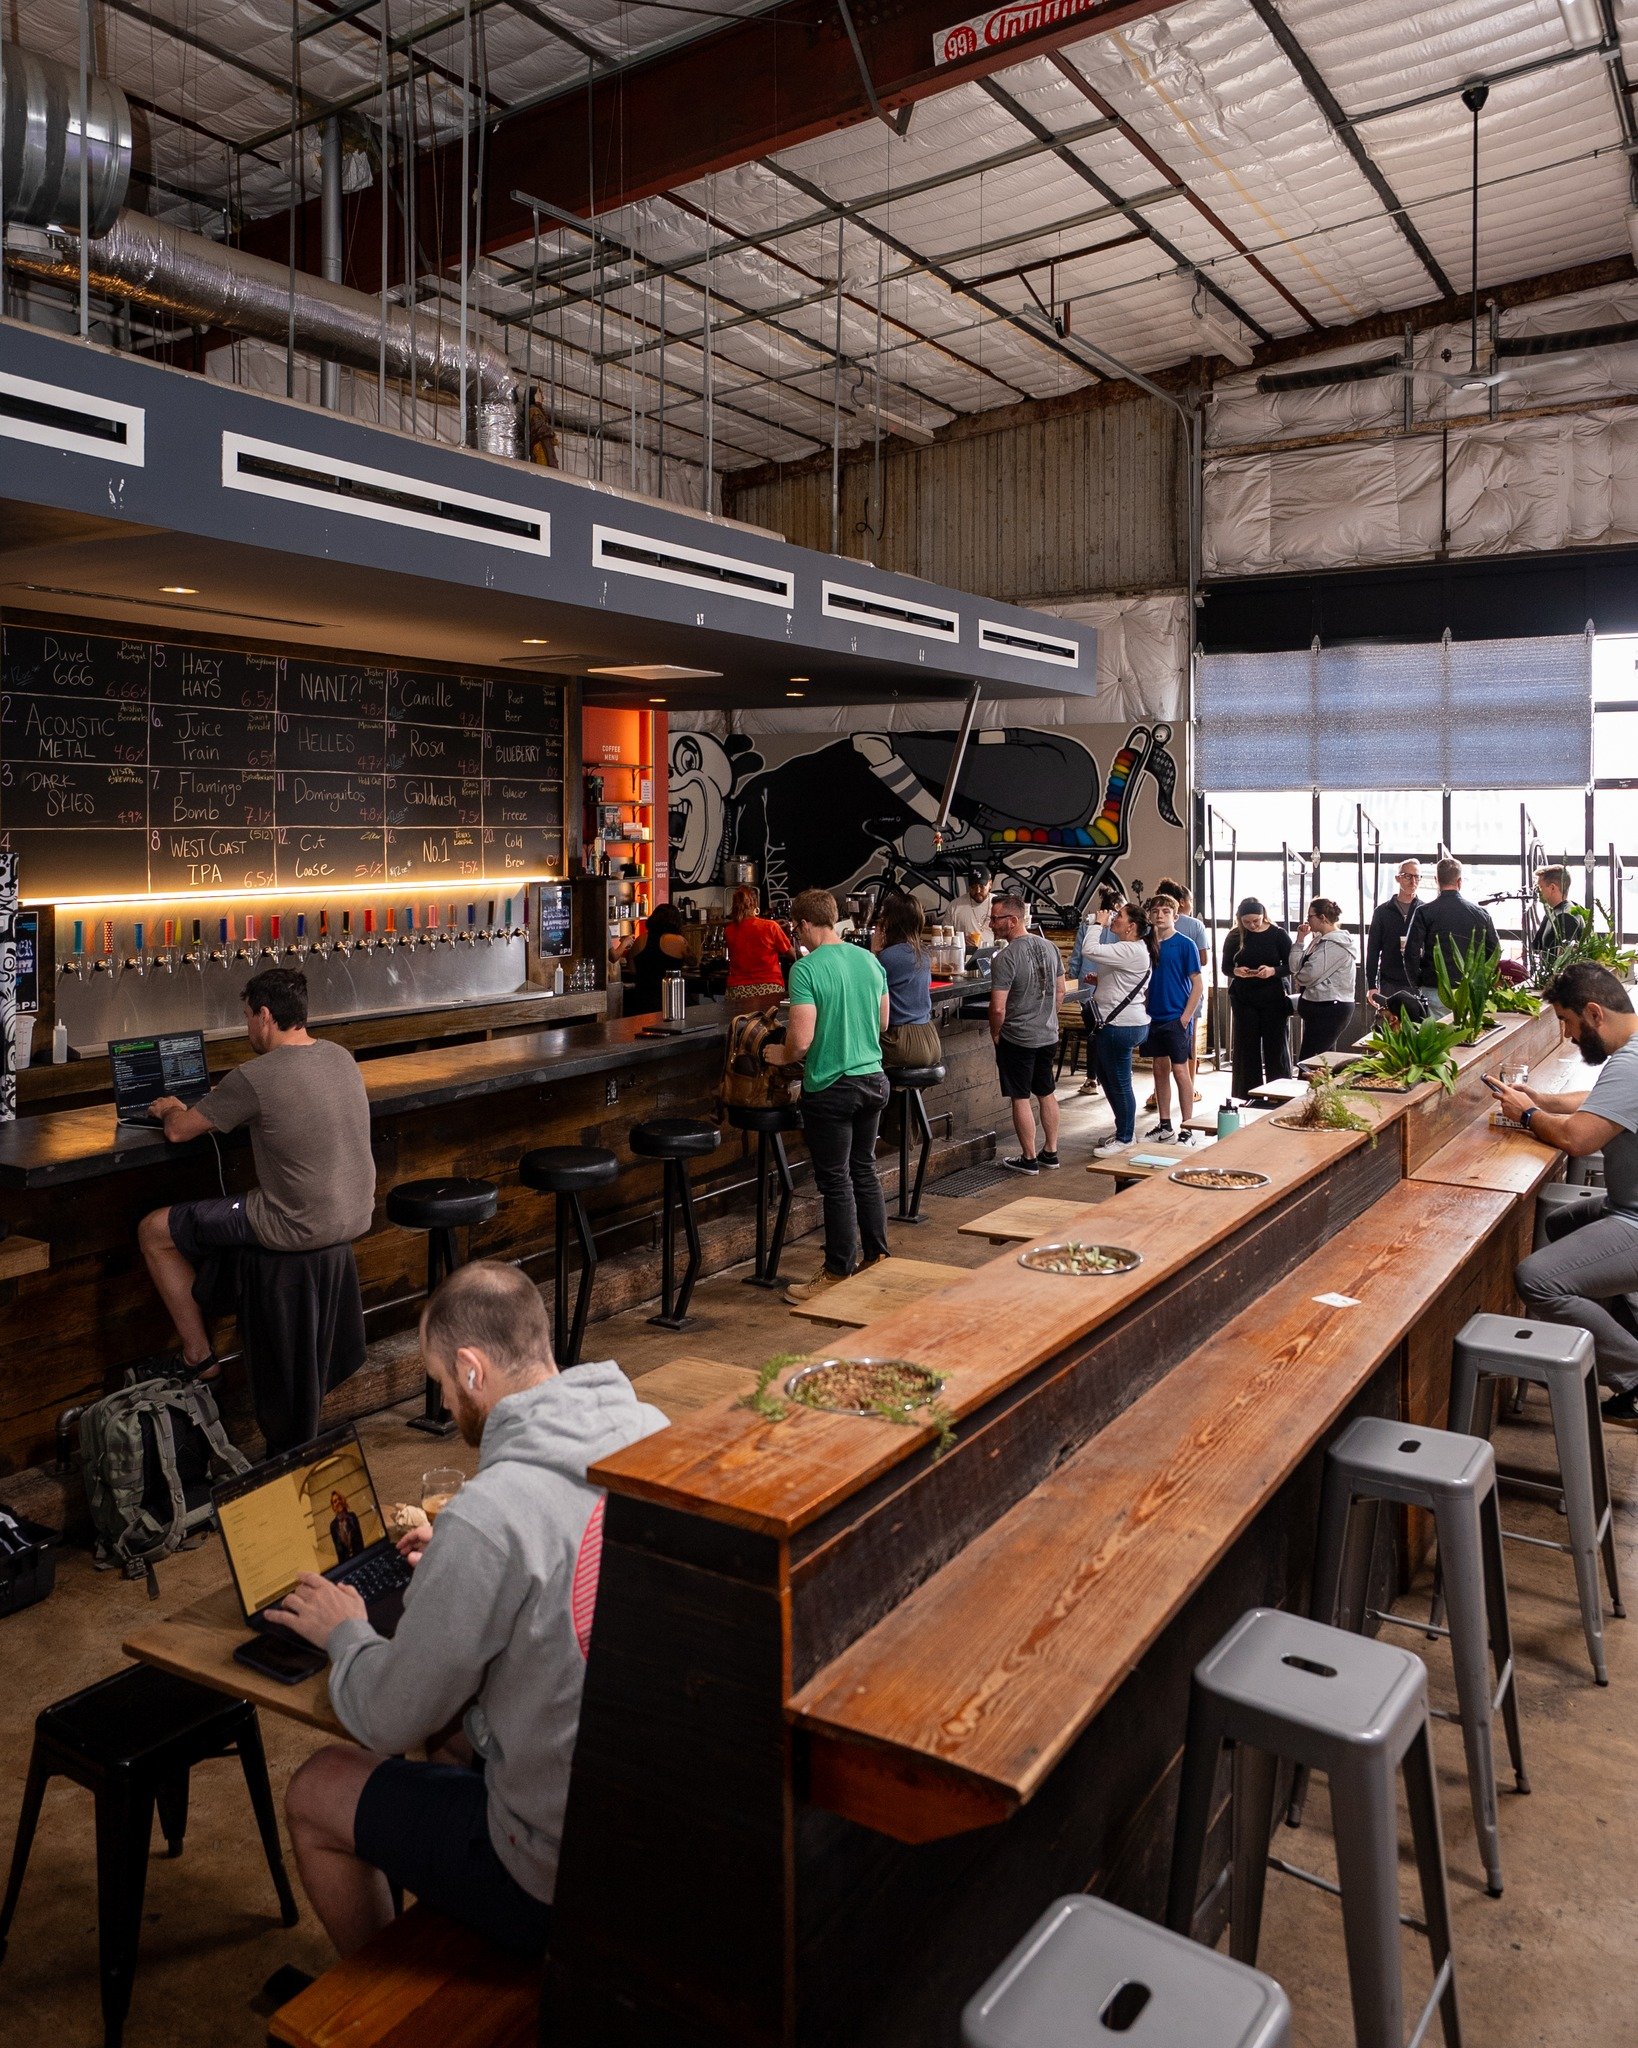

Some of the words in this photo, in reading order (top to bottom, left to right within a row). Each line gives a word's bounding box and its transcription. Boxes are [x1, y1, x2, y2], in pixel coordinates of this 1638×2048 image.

[948, 33, 968, 60] 99
[44, 636, 94, 662] Duvel
[154, 644, 168, 668] 5.
[53, 663, 94, 686] 666
[182, 652, 223, 678] HAZY
[105, 681, 148, 699] 6.66%
[182, 678, 222, 699] HAYS
[301, 672, 362, 703] NANI?!
[401, 679, 455, 708] Camille
[507, 689, 524, 704] Root
[241, 690, 274, 710] 6.5%
[25, 702, 115, 739] ACOUSTIC
[151, 707, 164, 728] 6.
[174, 712, 224, 740] Juice
[277, 713, 289, 733] 10
[505, 709, 523, 722] Beer
[39, 738, 96, 758] METAL
[172, 739, 220, 761] Train
[298, 726, 355, 753] HELLES
[410, 729, 446, 758] Rosa
[602, 745, 621, 753] COFFEE
[114, 744, 146, 762] 4.6%
[357, 755, 384, 771] 4.7%
[495, 745, 541, 763] BLUEBERRY
[1, 763, 16, 787] 3.
[458, 758, 480, 775] 4.8%
[25, 771, 76, 792] DARK
[150, 769, 161, 790] 7.
[179, 771, 242, 807] Flamingo
[46, 788, 95, 817] SKIES
[294, 777, 366, 813] Dominguitos
[404, 780, 457, 807] Goldrush
[502, 785, 528, 799] Glacier
[117, 810, 143, 824] 4.9%
[173, 796, 220, 823] Bomb
[244, 806, 272, 825] 7.1%
[360, 807, 384, 822] 4.8%
[459, 809, 480, 824] 7.5%
[502, 807, 528, 821] Freeze
[151, 829, 161, 851] 8
[170, 835, 205, 858] WEST
[209, 830, 247, 856] COAST
[250, 829, 274, 841] (512)
[300, 833, 326, 852] Cut
[505, 832, 523, 849] Cold
[295, 857, 335, 879] Loose
[458, 860, 479, 875] 7.5%
[505, 853, 525, 868] Brew
[187, 863, 223, 886] IPA
[244, 870, 274, 888] 6.5%
